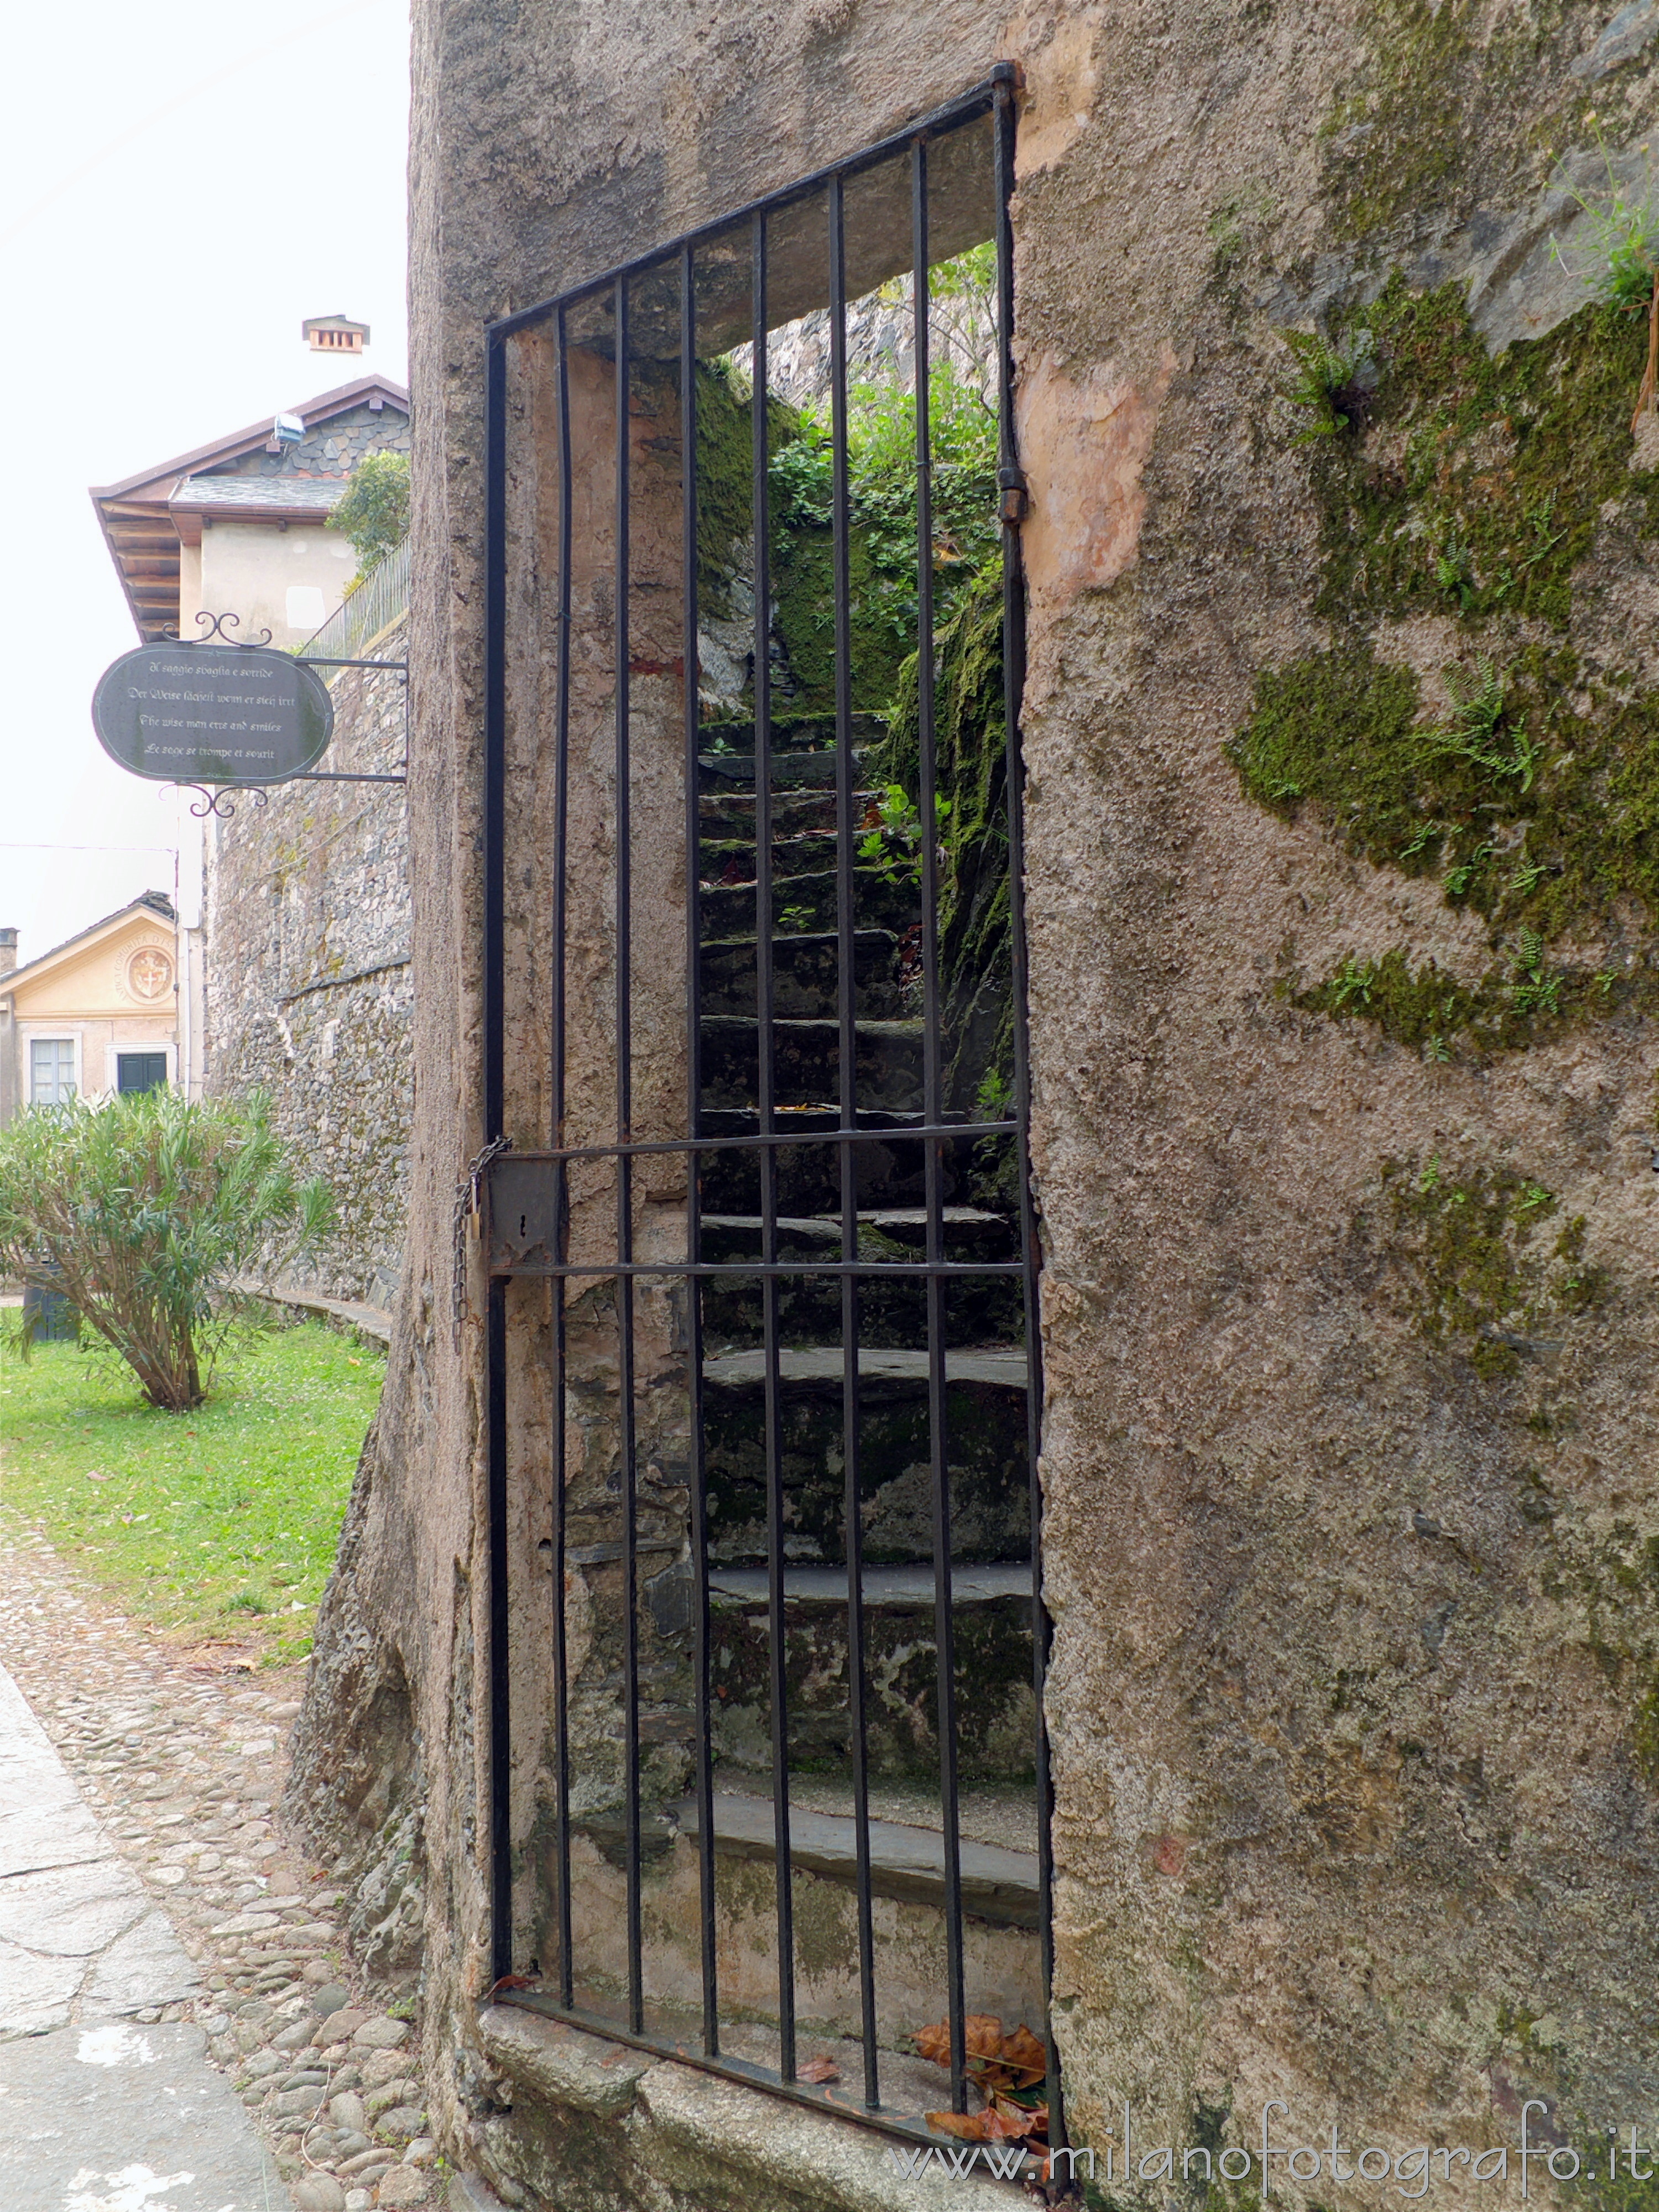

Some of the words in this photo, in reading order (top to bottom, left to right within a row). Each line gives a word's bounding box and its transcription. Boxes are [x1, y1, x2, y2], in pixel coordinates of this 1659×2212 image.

[150, 662, 160, 672] Il
[163, 665, 193, 676] saggio
[196, 666, 230, 677] sbaglia
[240, 670, 273, 678] sorride
[128, 687, 147, 698] Der
[150, 688, 181, 700] Weise
[217, 695, 242, 704] wenn
[256, 695, 275, 708] sich
[278, 696, 295, 707] irrt
[139, 714, 159, 727] The
[163, 719, 184, 727] wise
[230, 721, 247, 730] and
[250, 723, 282, 732] smiles
[144, 743, 159, 754] Le
[163, 747, 184, 758] sage
[199, 748, 231, 759] trompe
[234, 749, 243, 758] et
[246, 750, 274, 759] sourit
